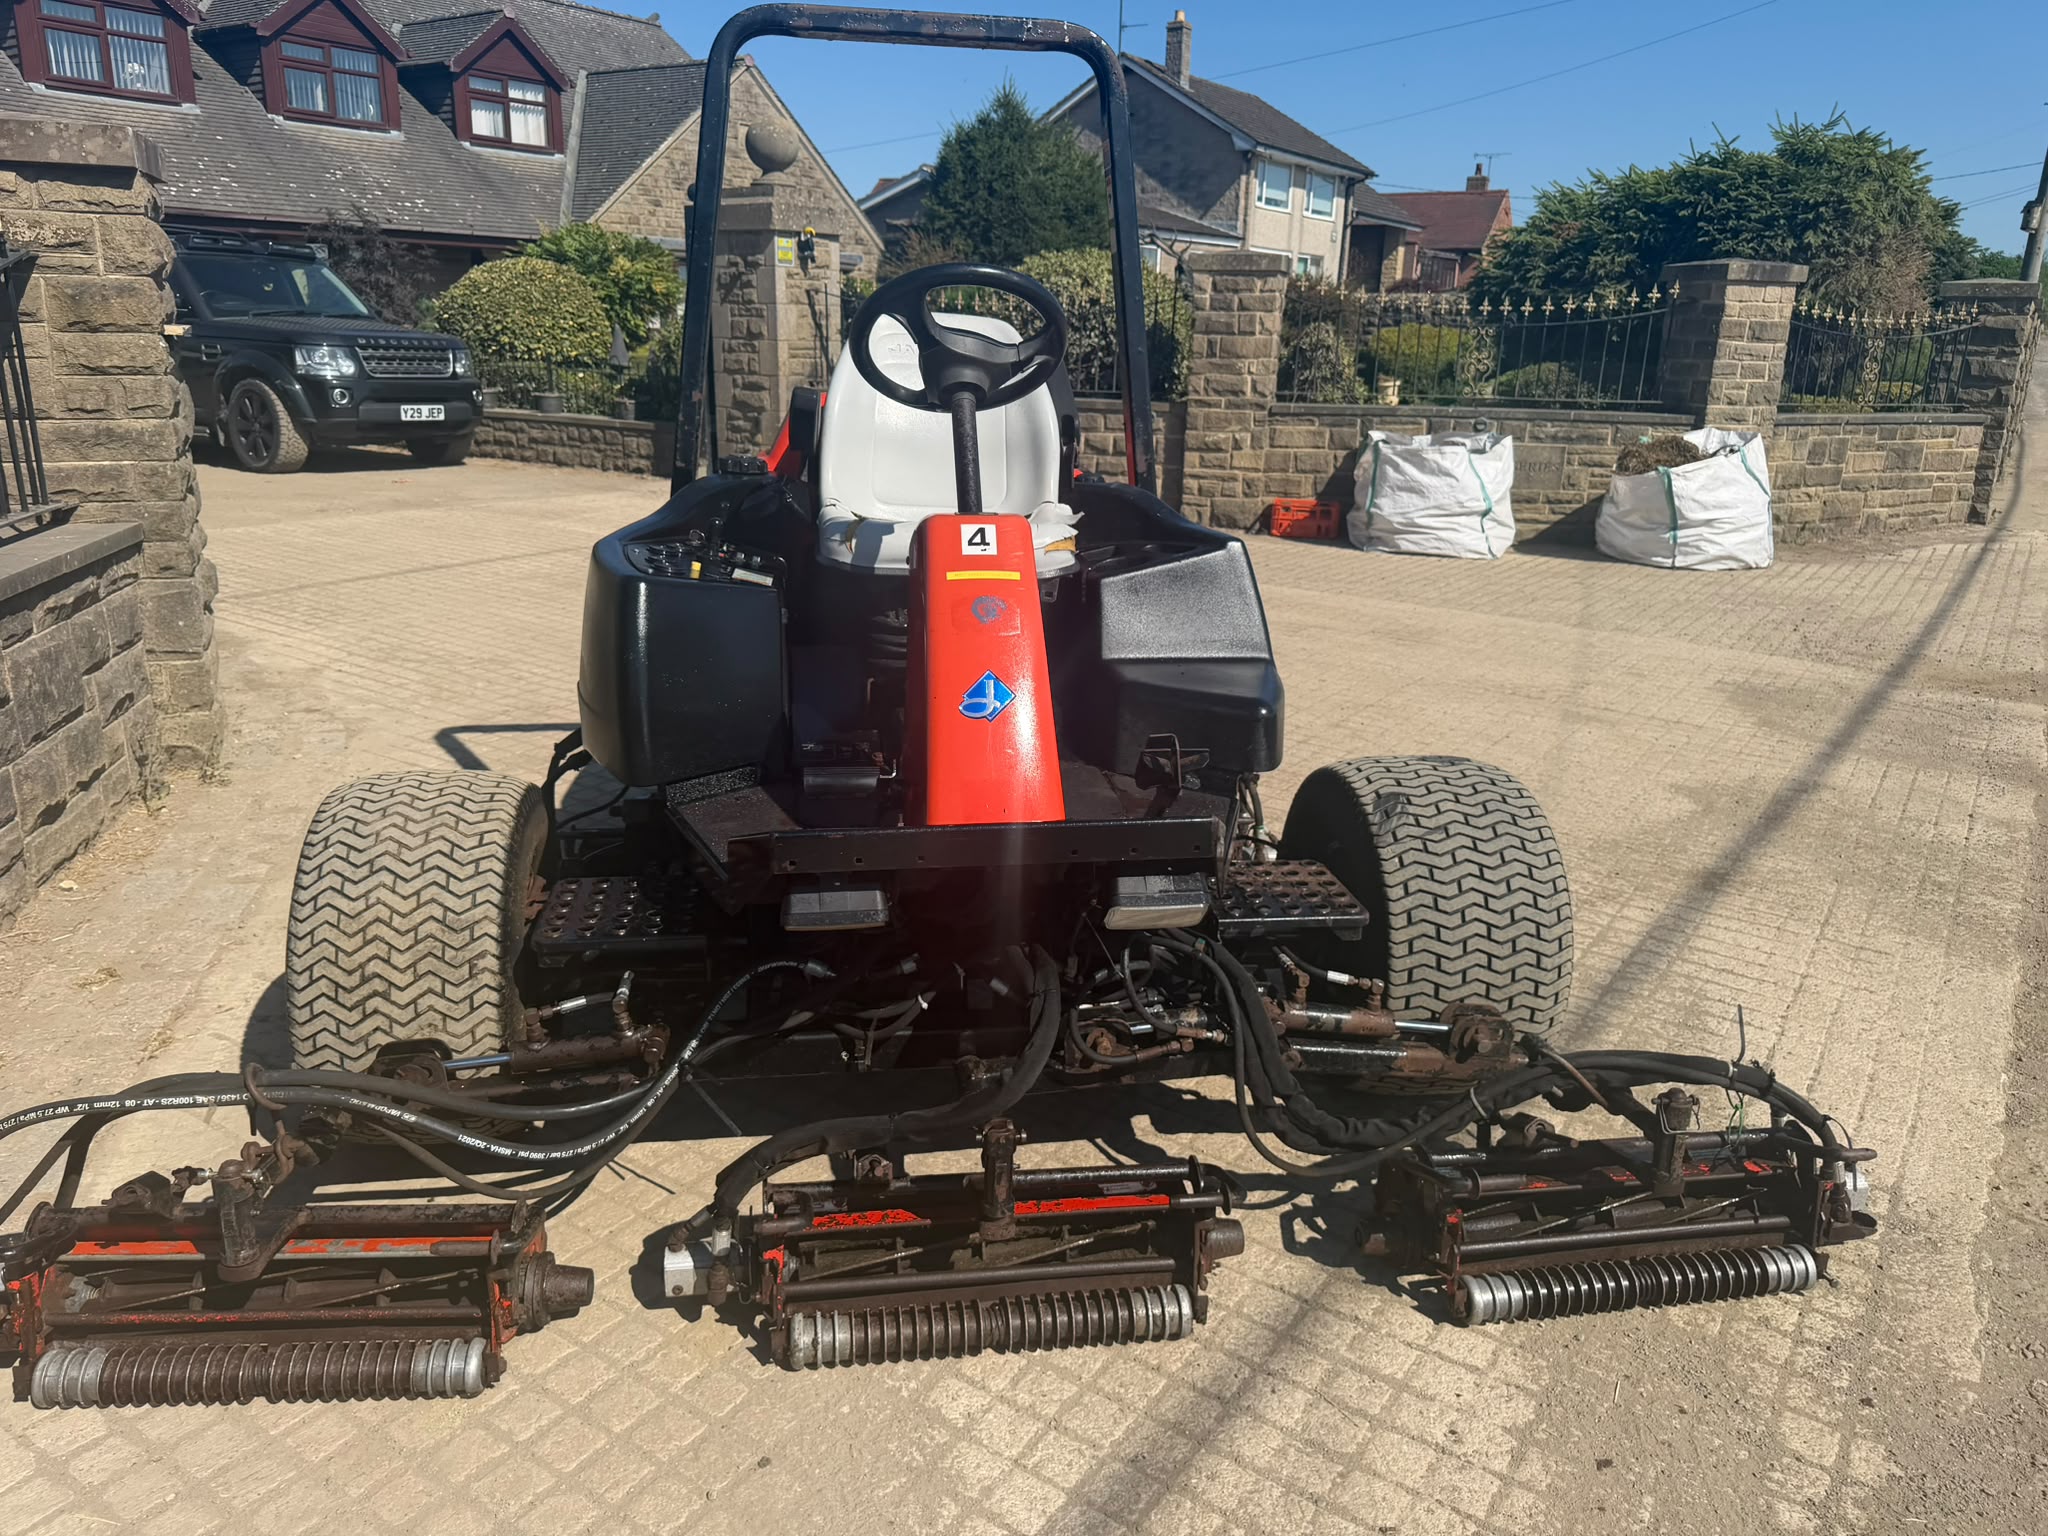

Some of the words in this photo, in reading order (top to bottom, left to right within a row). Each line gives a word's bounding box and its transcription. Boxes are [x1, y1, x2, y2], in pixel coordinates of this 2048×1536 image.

[402, 407, 422, 419] Y29
[425, 407, 443, 419] JEP
[967, 527, 990, 547] 4
[161, 1096, 194, 1105] 100R2S
[196, 1096, 216, 1104] SAE
[221, 1093, 241, 1102] 1436
[94, 1100, 121, 1108] 12mm
[124, 1099, 136, 1107] 08
[55, 1105, 70, 1114] WP
[457, 1133, 487, 1149] 2Q/2021
[490, 1144, 513, 1156] MSHA
